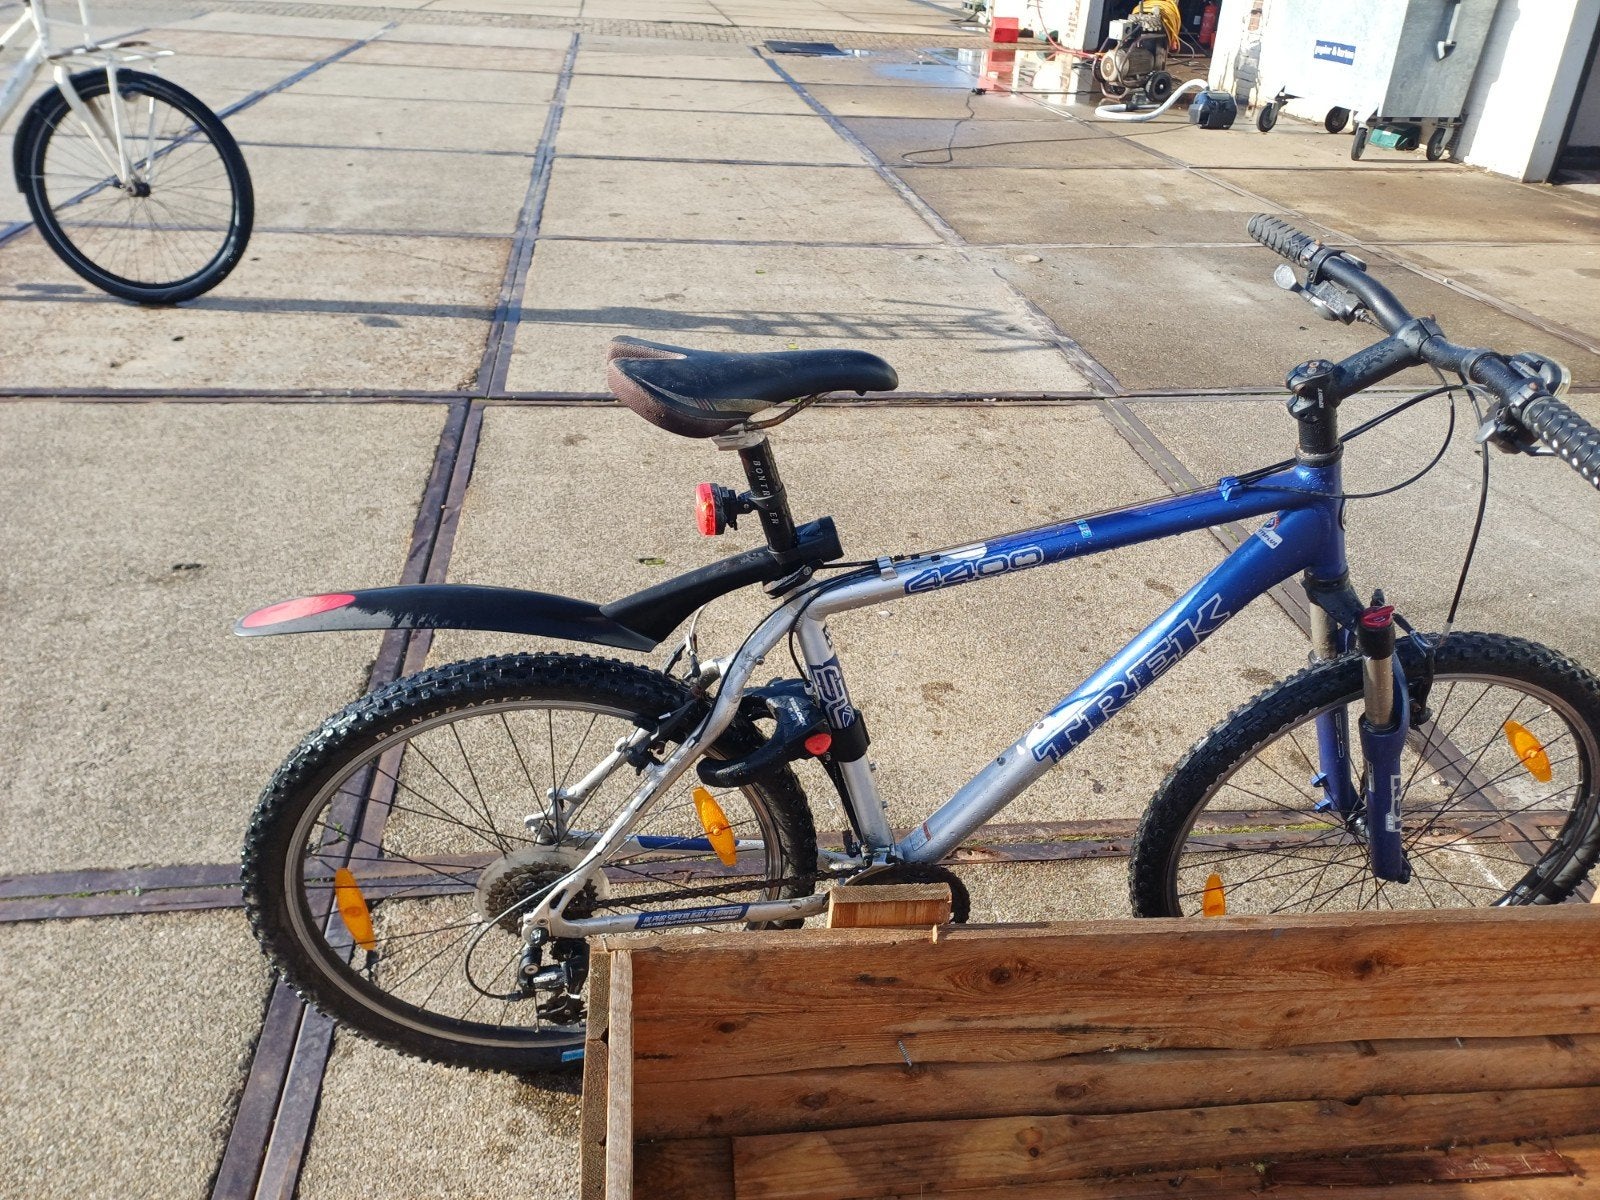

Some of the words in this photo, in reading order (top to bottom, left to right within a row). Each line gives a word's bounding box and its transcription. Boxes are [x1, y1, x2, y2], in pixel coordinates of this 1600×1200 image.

[752, 459, 779, 526] BONTRER
[903, 543, 1046, 595] 4400
[1031, 592, 1232, 764] TREK
[375, 695, 532, 741] BONTRAGER
